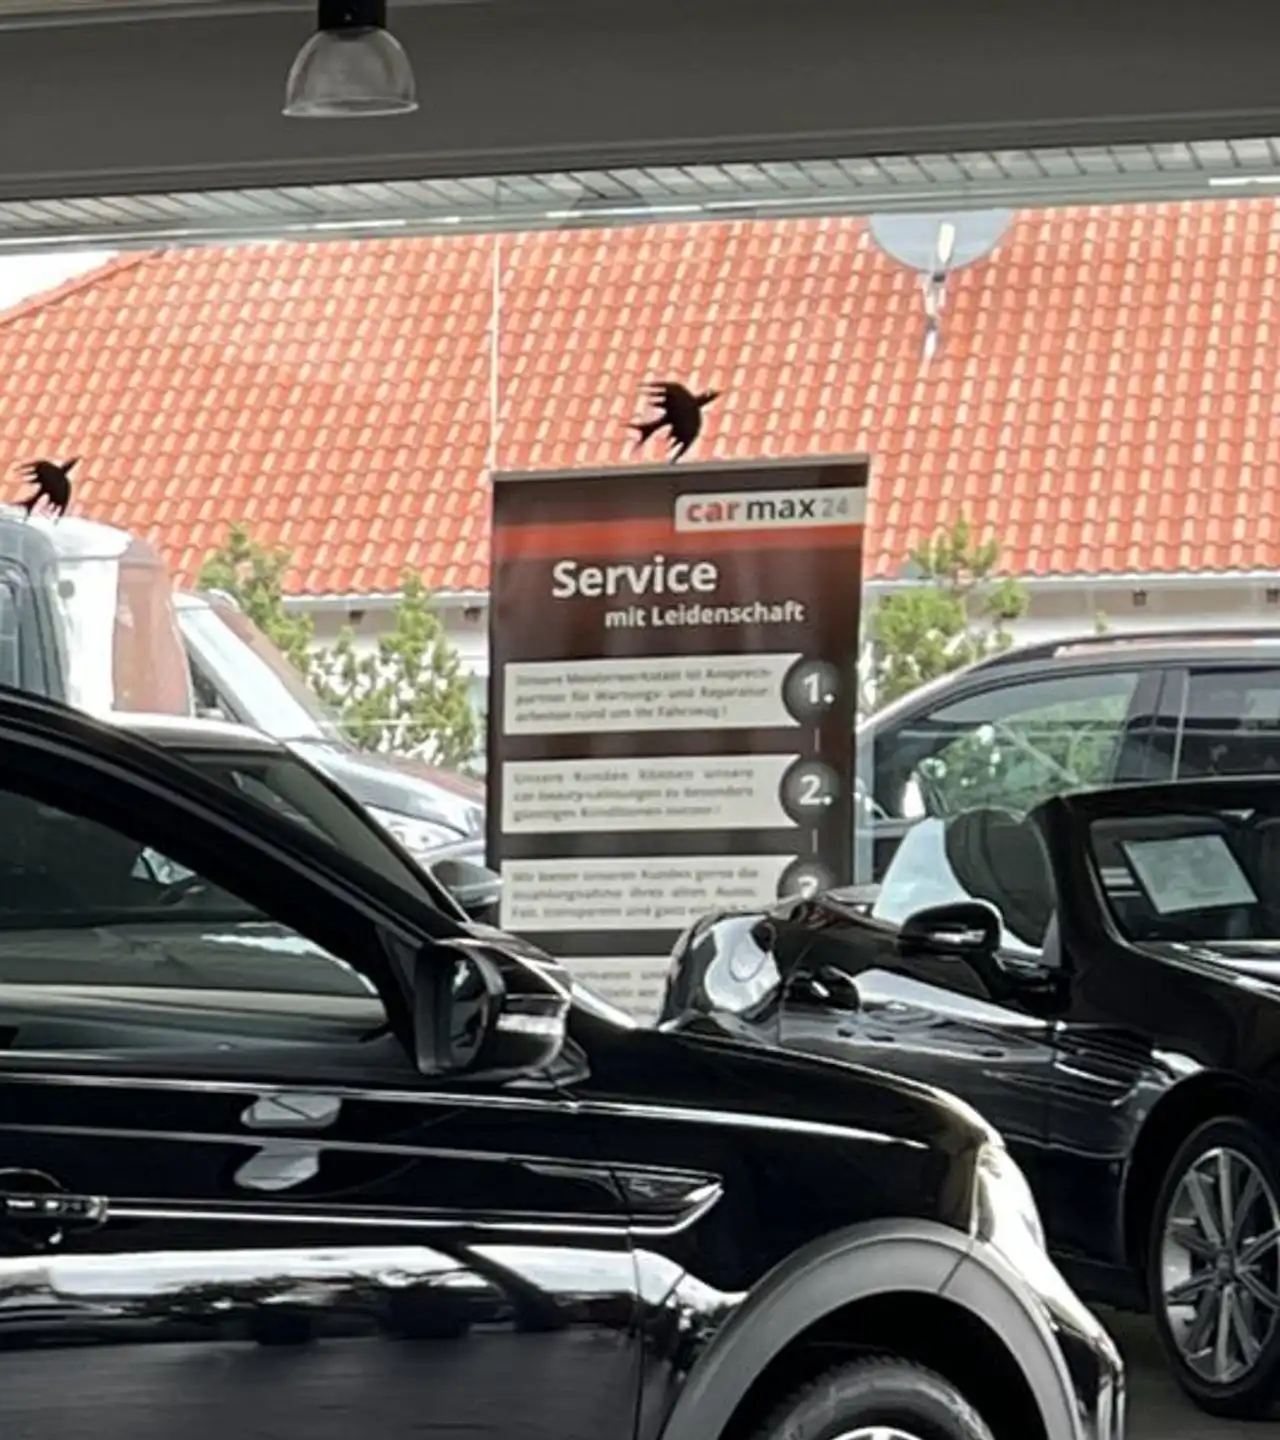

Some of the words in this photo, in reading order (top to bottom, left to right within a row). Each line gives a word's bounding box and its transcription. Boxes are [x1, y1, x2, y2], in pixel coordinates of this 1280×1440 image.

[551, 555, 719, 598] Service
[604, 604, 646, 628] mit
[651, 600, 805, 627] Leidenschaft
[803, 672, 835, 704] 1.
[799, 774, 833, 806] 2.
